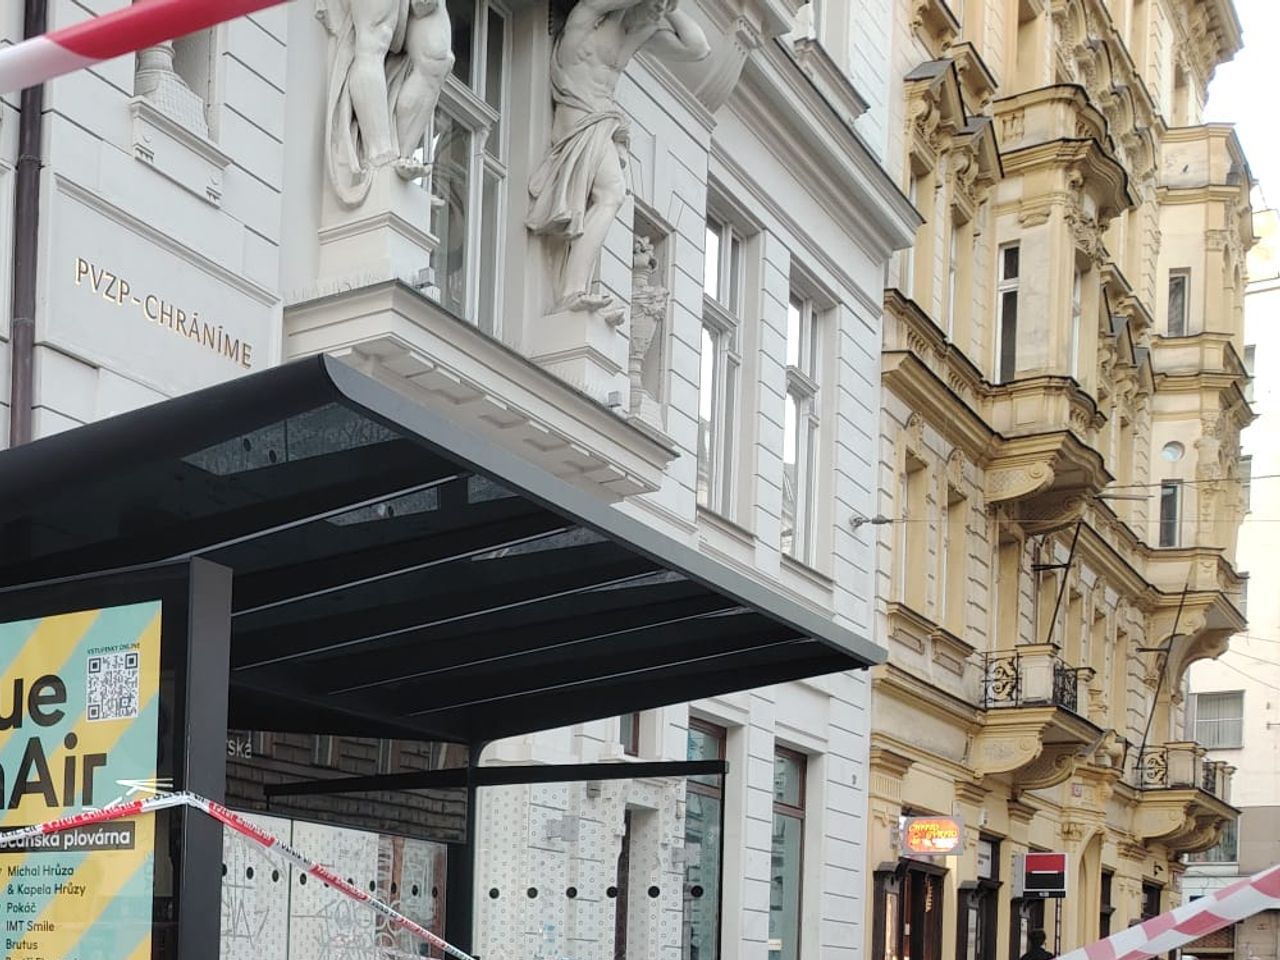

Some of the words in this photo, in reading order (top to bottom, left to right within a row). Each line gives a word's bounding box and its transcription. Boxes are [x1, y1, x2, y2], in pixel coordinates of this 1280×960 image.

[225, 736, 252, 759] ská
[64, 828, 131, 849] plovárna
[7, 865, 40, 877] Michal
[43, 863, 74, 876] Hrůza
[7, 884, 14, 895] &
[18, 884, 51, 897] Kapela
[54, 882, 86, 897] Hrůzy
[7, 902, 36, 913] Pokáč
[6, 920, 24, 932] IMT
[27, 920, 55, 932] Smile
[6, 939, 38, 950] Brutus
